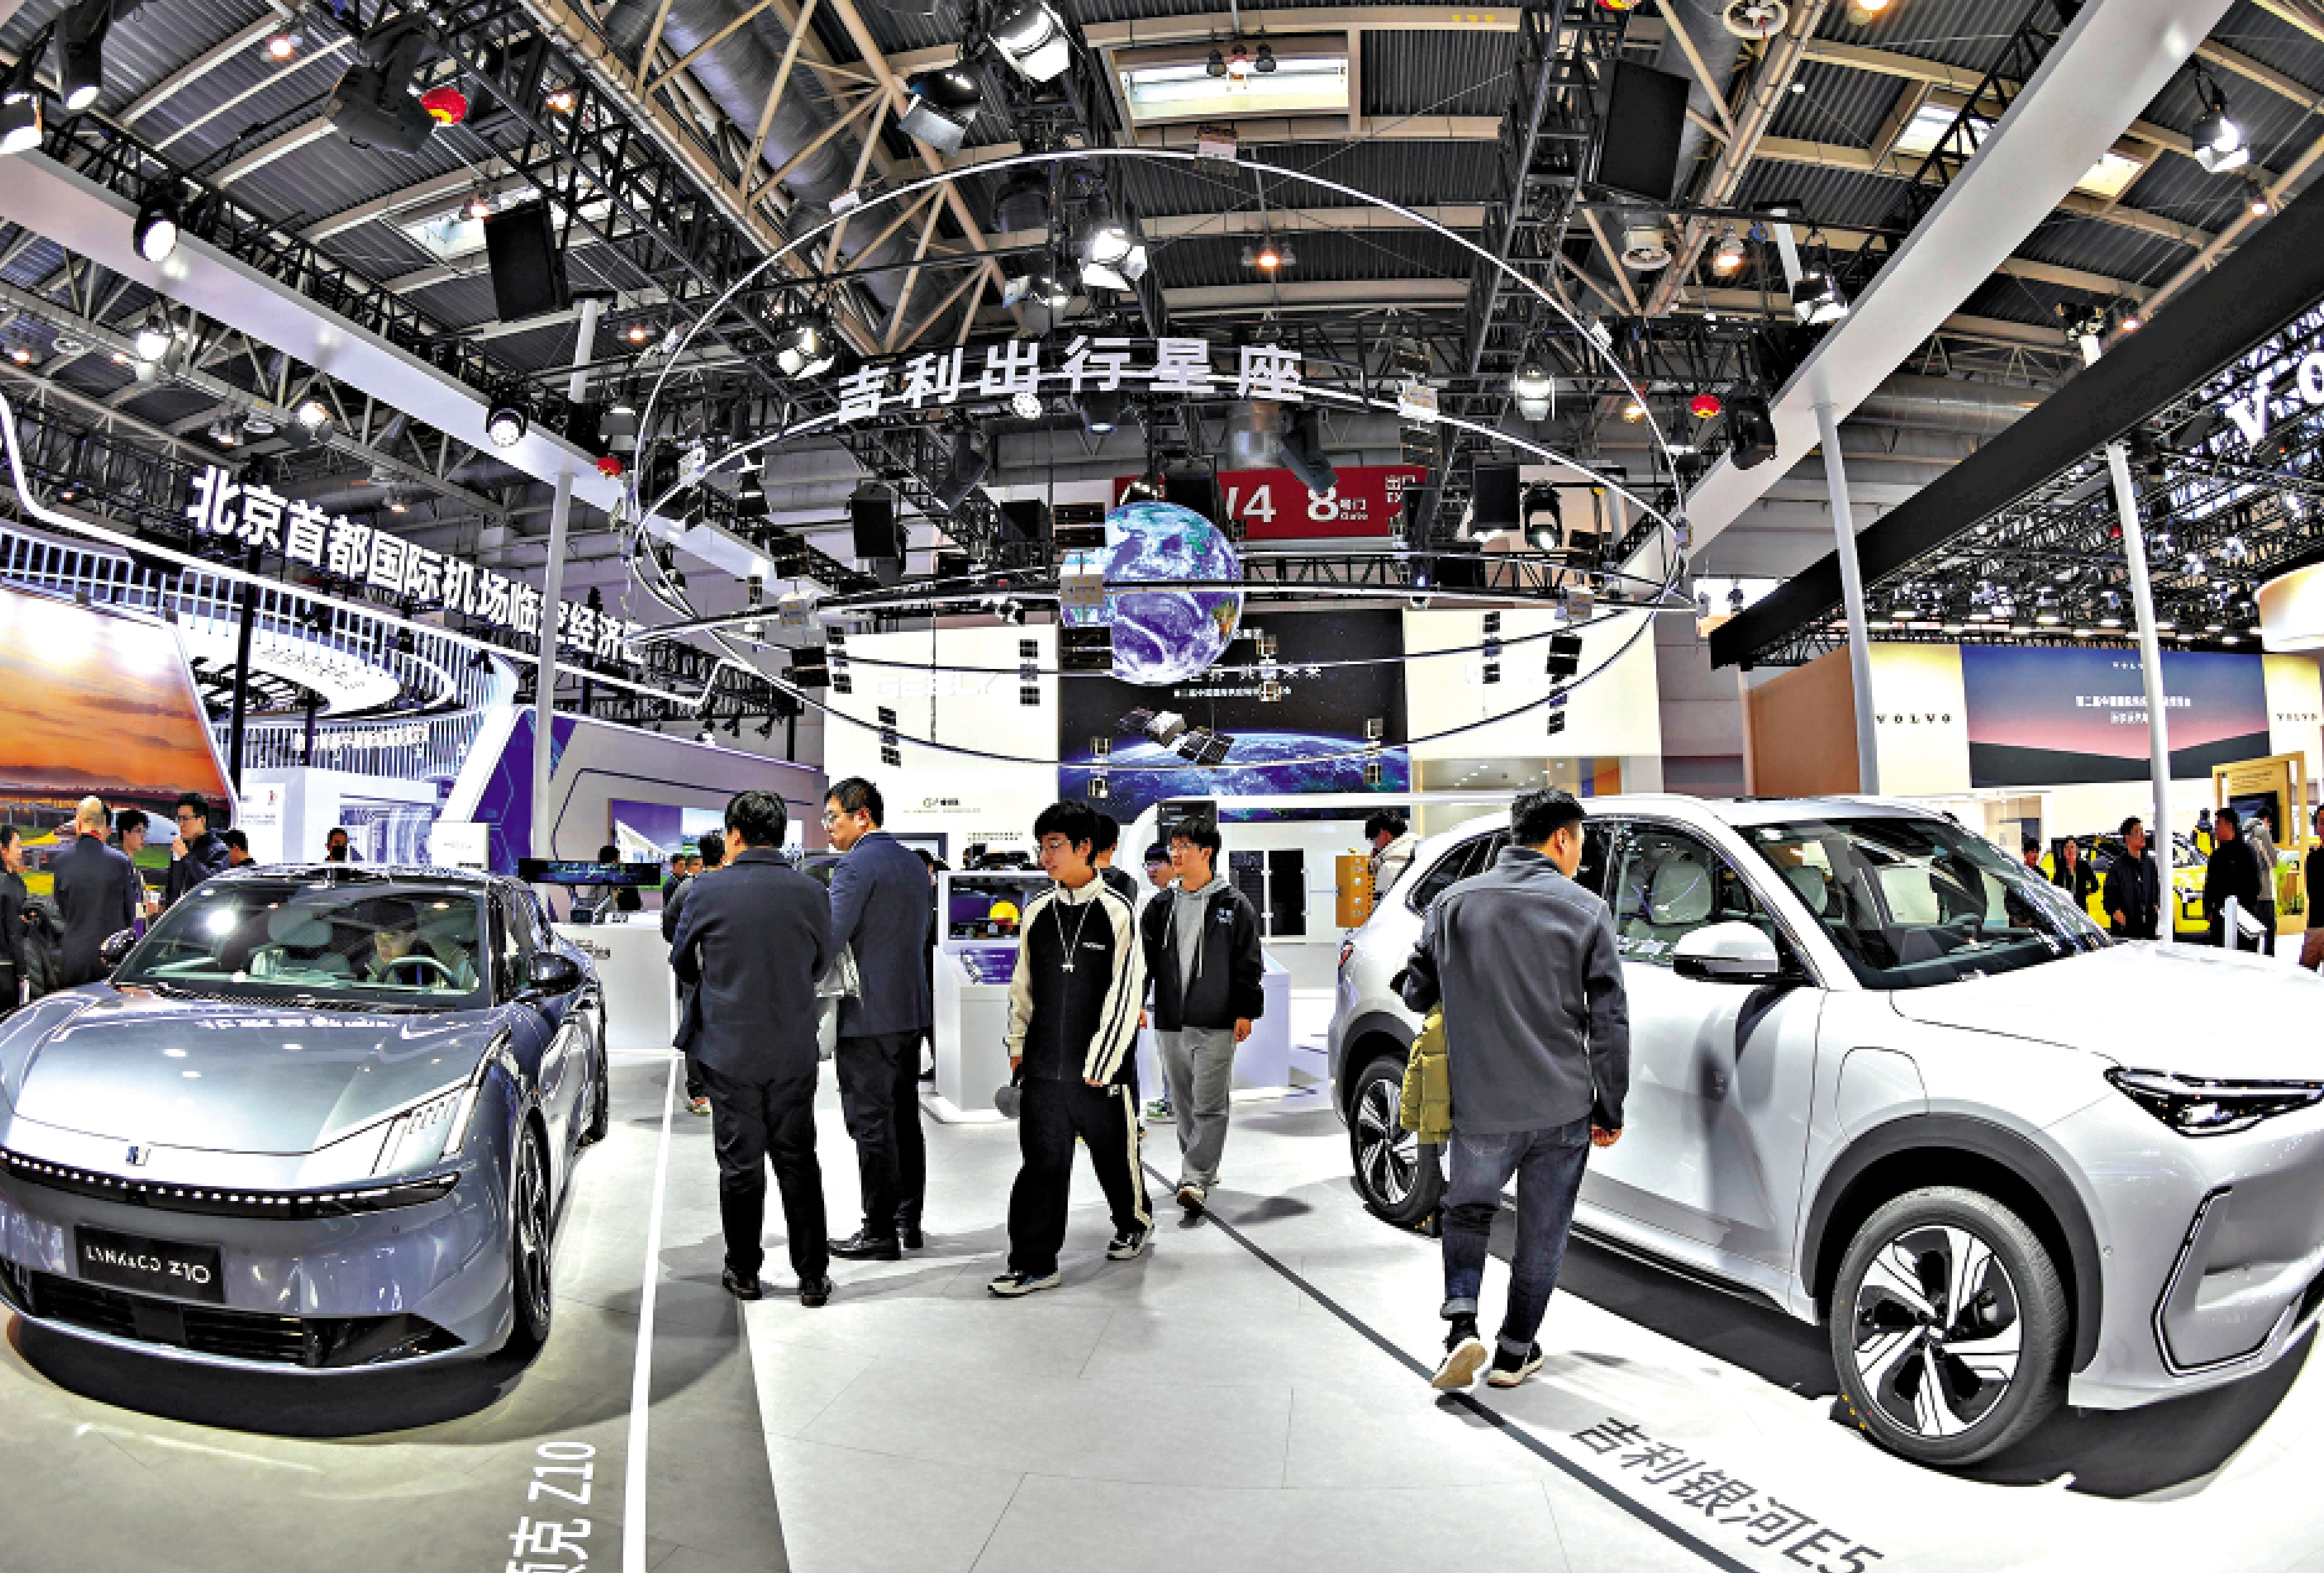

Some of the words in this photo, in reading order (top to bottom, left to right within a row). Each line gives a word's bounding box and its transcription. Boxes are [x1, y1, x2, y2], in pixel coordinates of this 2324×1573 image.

[838, 335, 1304, 423] 吉利出行星座
[1875, 713, 1951, 724] VOLVO
[168, 1260, 211, 1284] Z10
[528, 1442, 595, 1505] Z10
